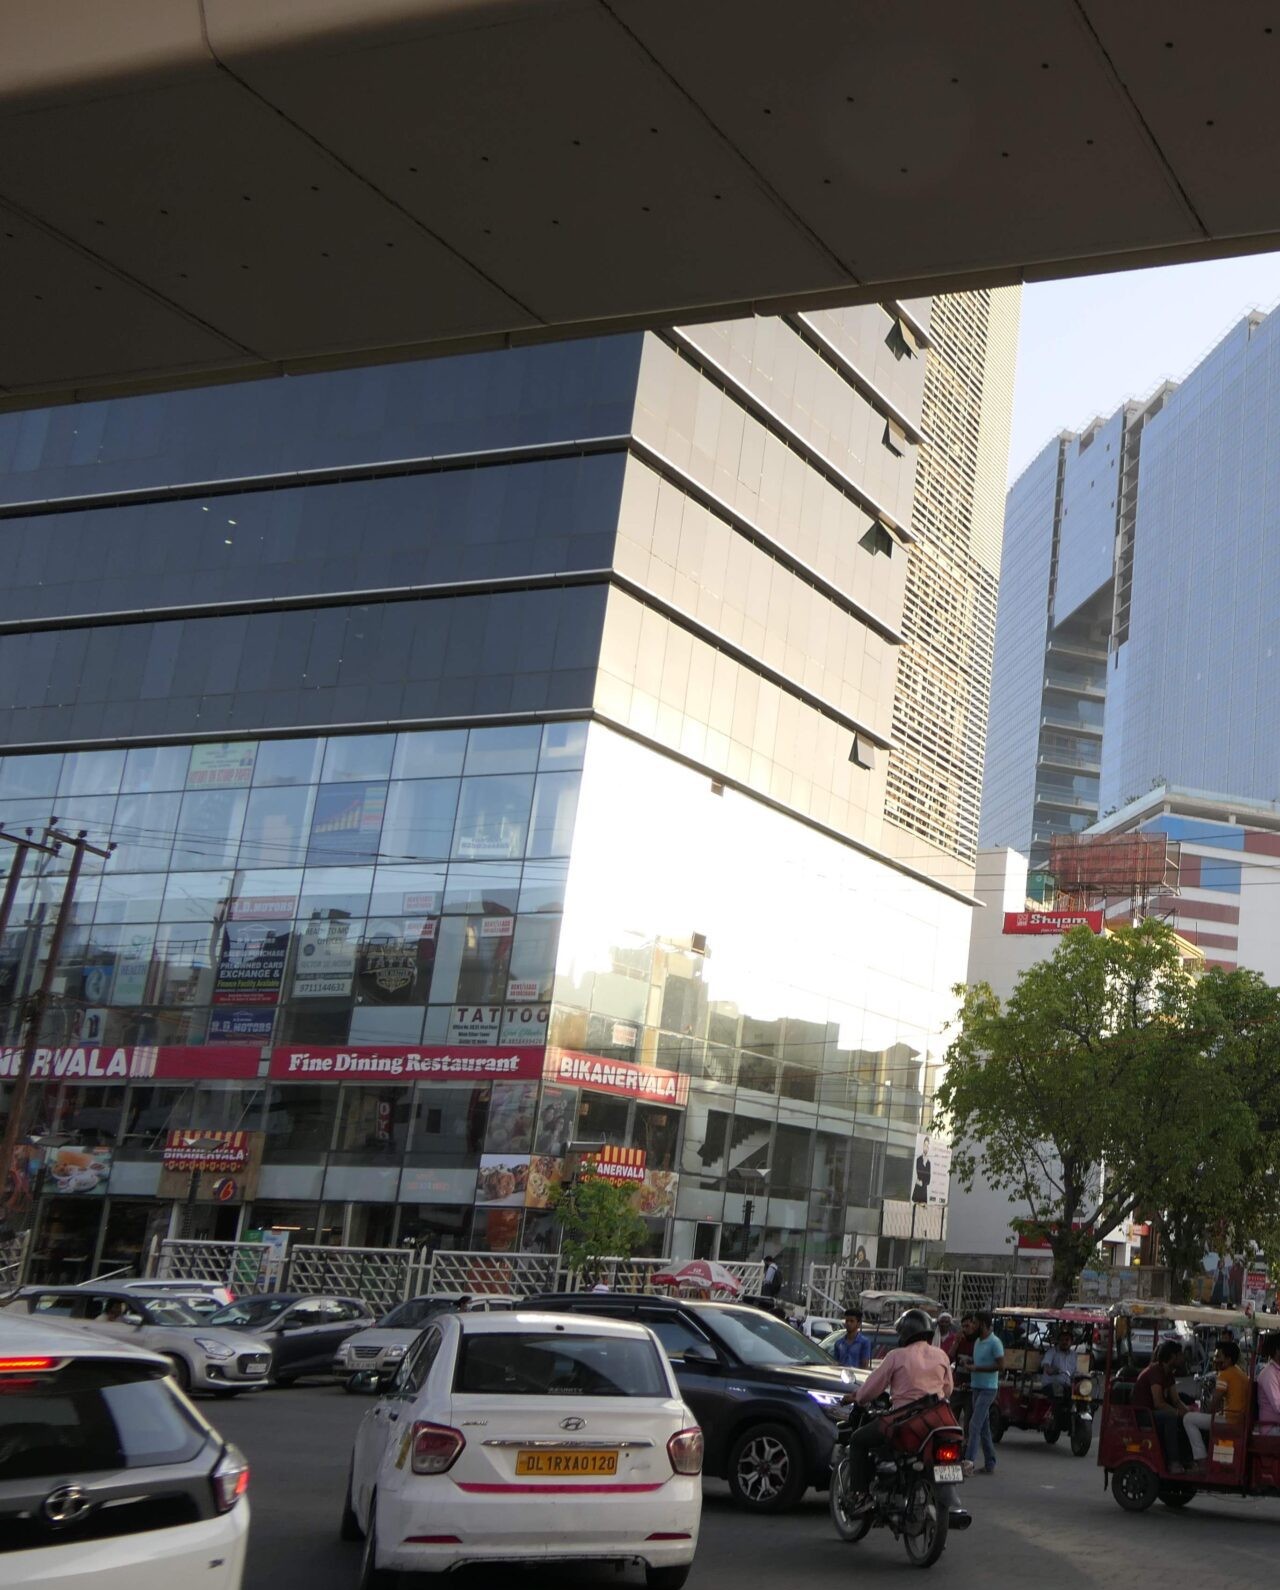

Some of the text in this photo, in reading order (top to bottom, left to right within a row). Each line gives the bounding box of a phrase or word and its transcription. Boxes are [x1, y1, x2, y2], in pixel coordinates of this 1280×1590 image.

[1030, 913, 1088, 928] Shyam
[219, 969, 271, 978] EXCHANGE
[288, 1053, 521, 1074] Fine Dining Restaurant
[559, 1056, 677, 1097] BIKANERVALA
